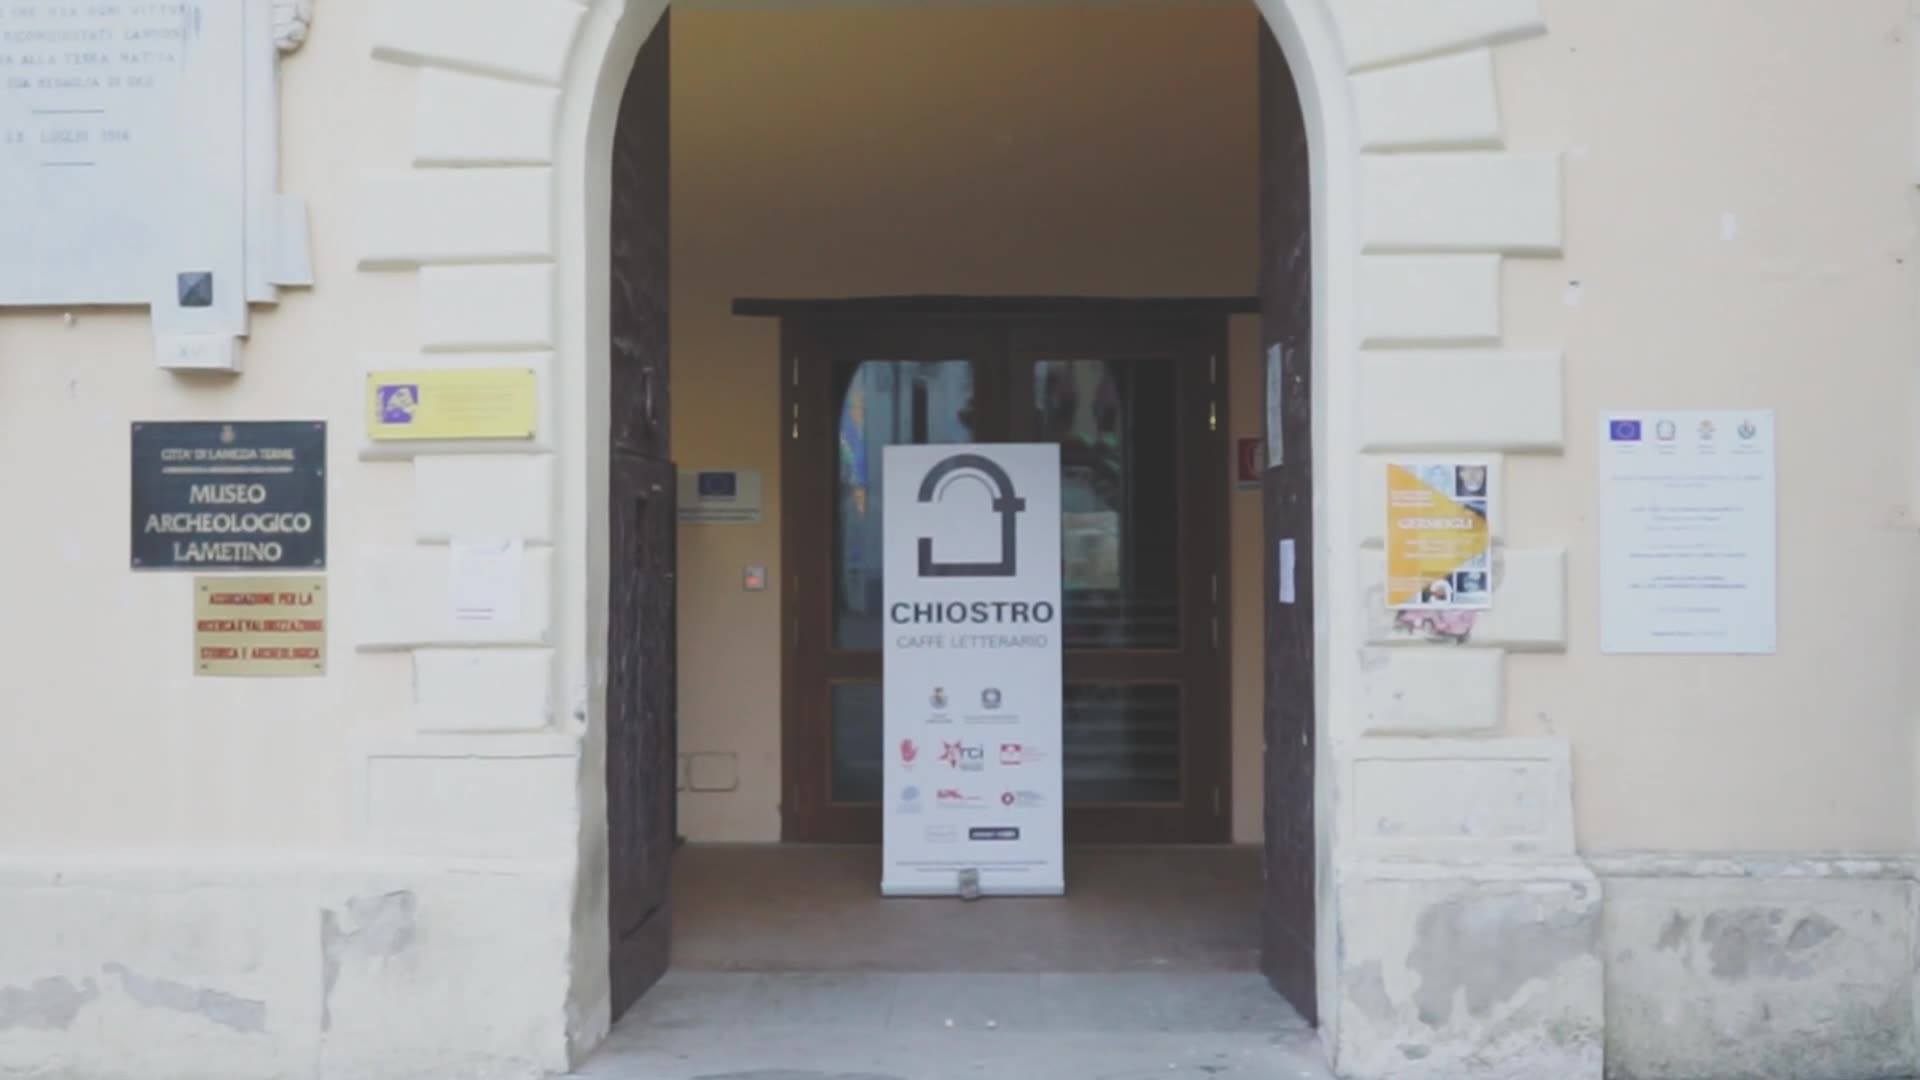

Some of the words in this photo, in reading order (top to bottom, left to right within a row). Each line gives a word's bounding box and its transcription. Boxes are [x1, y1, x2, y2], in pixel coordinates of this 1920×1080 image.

[190, 484, 266, 504] MUSEO
[144, 513, 312, 533] ARCHEOLOGICO
[173, 542, 283, 562] LAMETINO
[278, 593, 296, 605] PER
[299, 592, 313, 606] LA
[890, 600, 1054, 624] CHIOSTRO
[950, 634, 1048, 649] LETTERARIO
